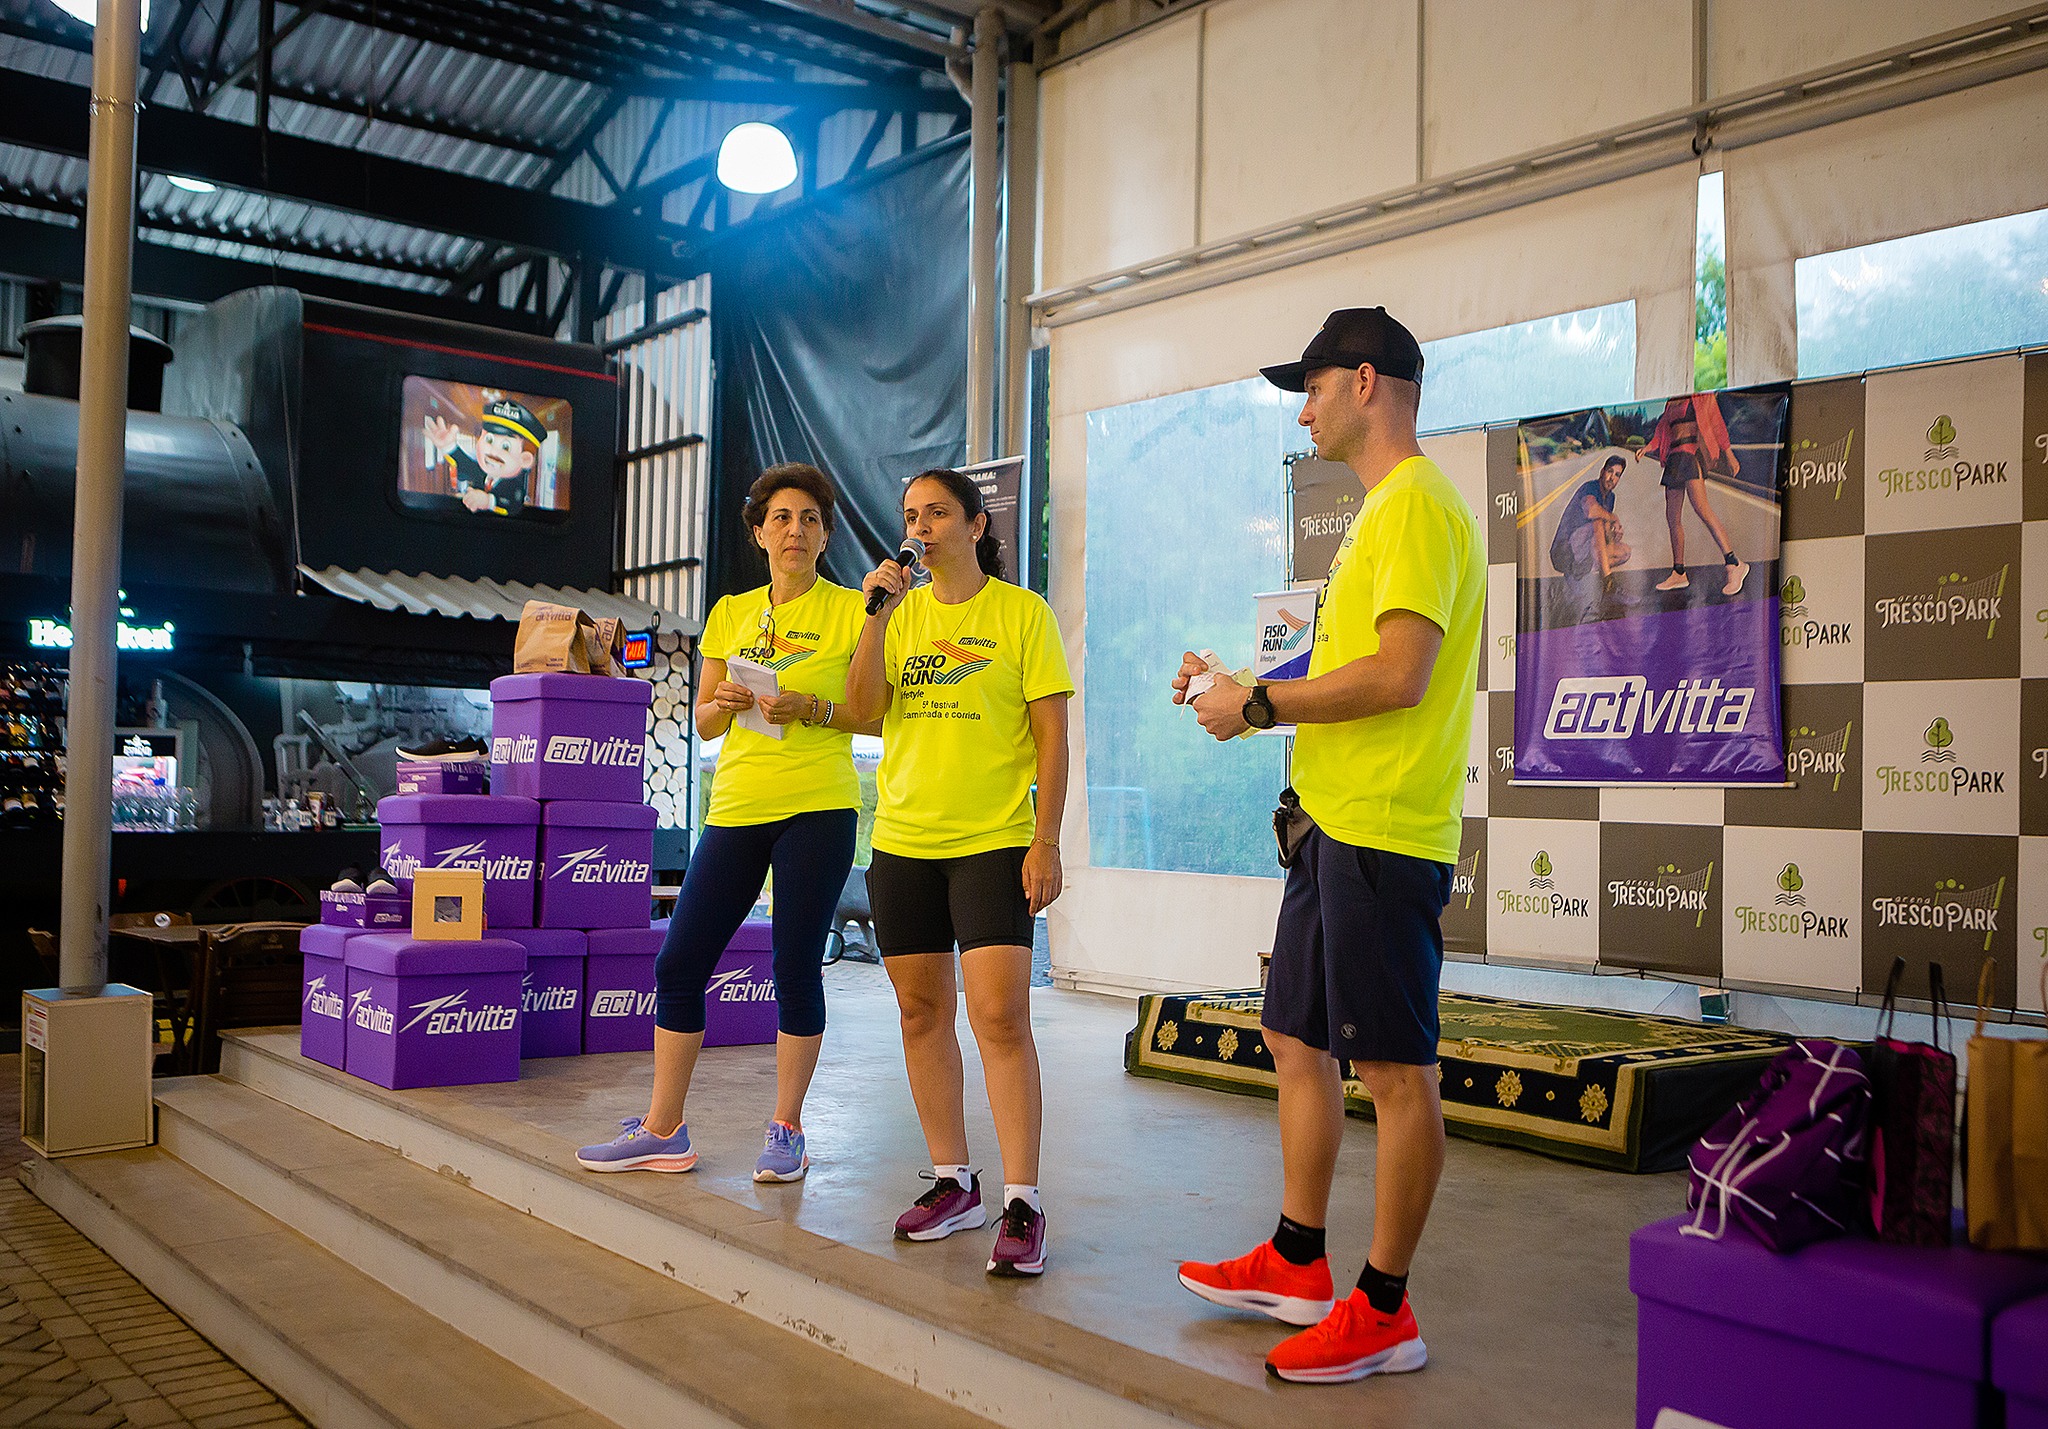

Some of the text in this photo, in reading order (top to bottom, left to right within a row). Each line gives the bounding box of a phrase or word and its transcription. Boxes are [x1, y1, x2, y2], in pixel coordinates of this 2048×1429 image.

[28, 619, 175, 650] Heken
[1264, 623, 1288, 639] FISIO
[1262, 637, 1283, 652] RUN
[903, 654, 947, 672] FISIO
[1259, 654, 1277, 663] lifestyle
[900, 669, 935, 688] RUN
[903, 710, 981, 720] caminhada e corrida
[930, 700, 959, 709] festival
[1544, 677, 1756, 739] actvitta
[491, 734, 538, 765] actvitta
[544, 735, 644, 767] actvitta
[571, 858, 649, 883] actvitta
[1625, 878, 1655, 887] arena
[1894, 895, 1931, 903] arena
[310, 990, 344, 1020] actvitta
[521, 985, 578, 1013] tvitta
[355, 1005, 395, 1035] actvitta
[426, 1004, 518, 1035] actvitta
